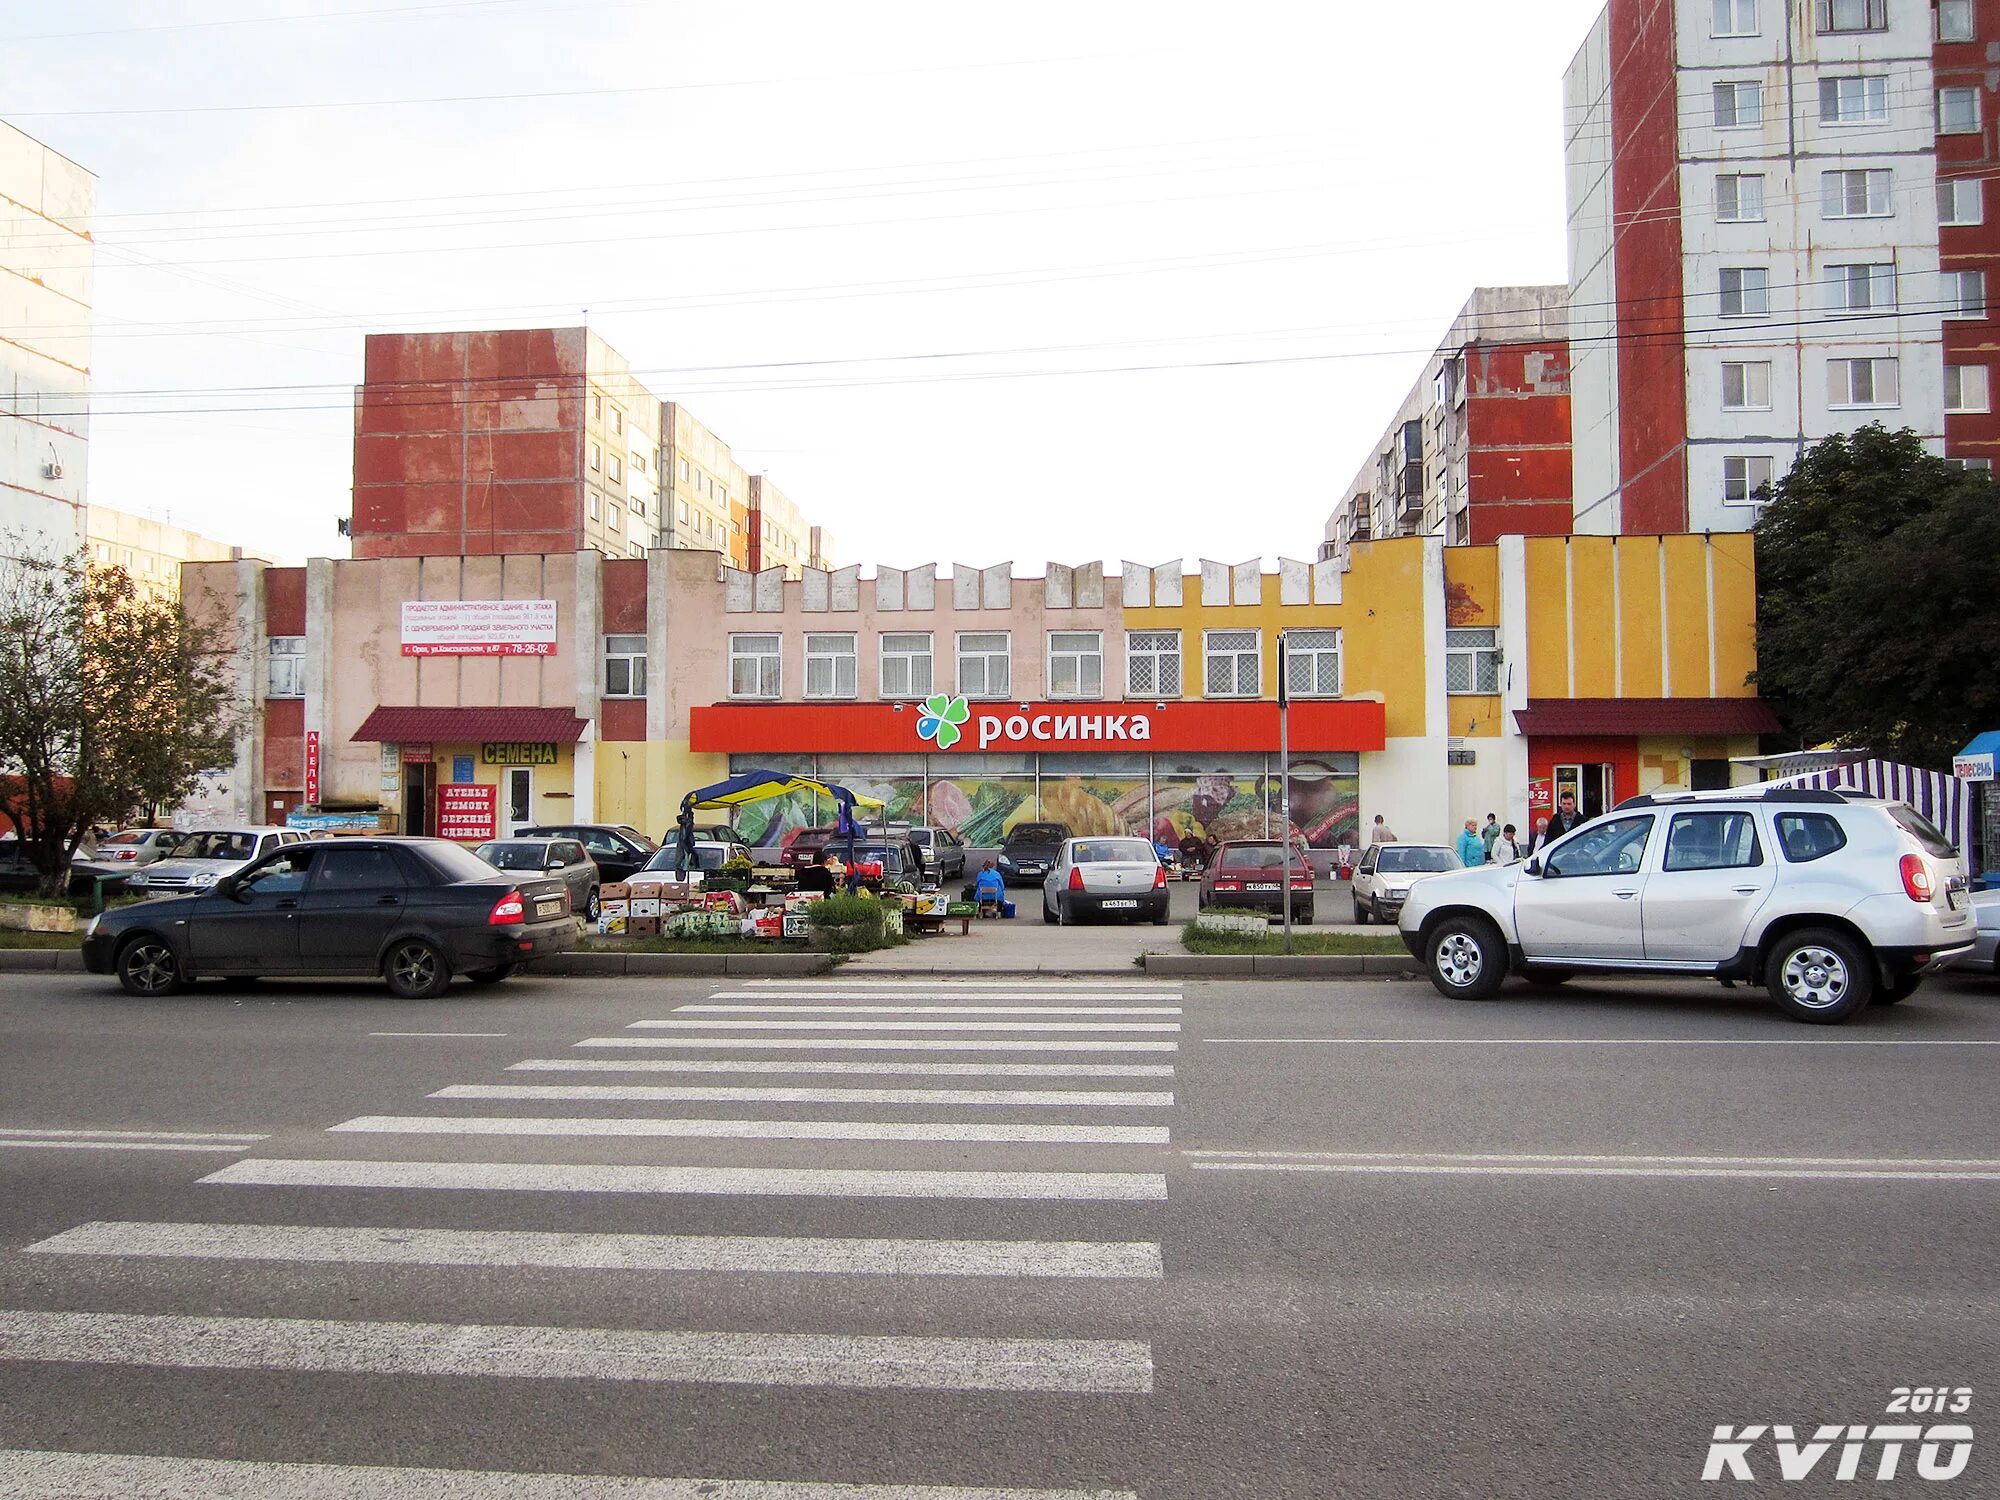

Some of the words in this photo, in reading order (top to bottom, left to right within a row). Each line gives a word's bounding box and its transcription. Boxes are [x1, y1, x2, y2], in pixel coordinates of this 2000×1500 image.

[439, 604, 499, 612] АДМИНИСТРАТИВНОЕ
[501, 603, 524, 611] ЗДАНИЕ
[533, 603, 552, 611] ЭТАЖА
[411, 624, 459, 632] ОДНОВРЕМЕННОЙ
[461, 624, 491, 632] ПРОДАЖЕЙ
[530, 624, 553, 632] УЧАСТКА
[979, 714, 1151, 750] росинка
[484, 743, 555, 764] СЕМЕНА
[308, 732, 317, 802] АТЕЛЬЕ
[446, 788, 488, 798] АТЕЛЬЕ
[445, 801, 490, 811] РЕМОНТ
[441, 813, 492, 824] ВЕРХНЕЙ
[442, 827, 491, 838] ОДЕЖДЫ
